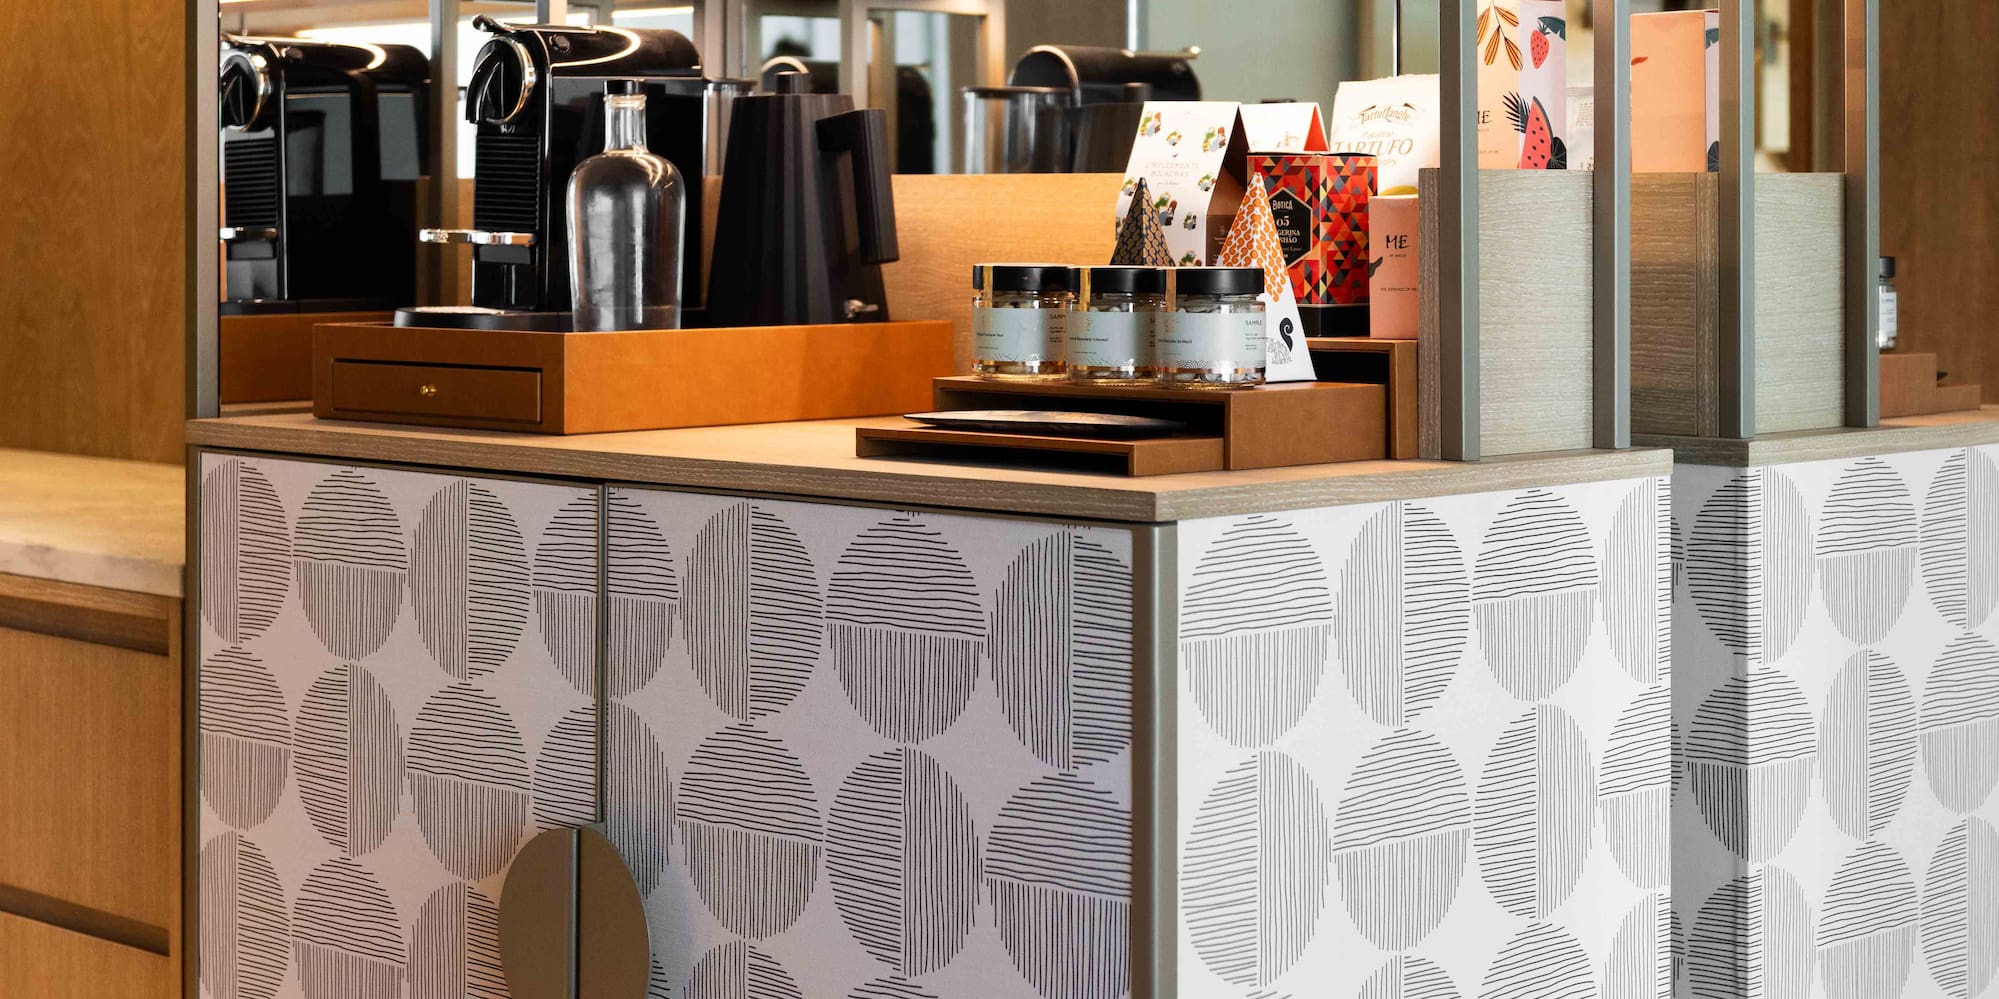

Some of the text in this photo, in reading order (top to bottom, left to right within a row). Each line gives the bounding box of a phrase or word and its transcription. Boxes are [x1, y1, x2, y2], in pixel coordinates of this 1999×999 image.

[1334, 138, 1414, 157] TARTUFO
[1272, 199, 1293, 211] BOTICA
[1385, 234, 1409, 250] ME
